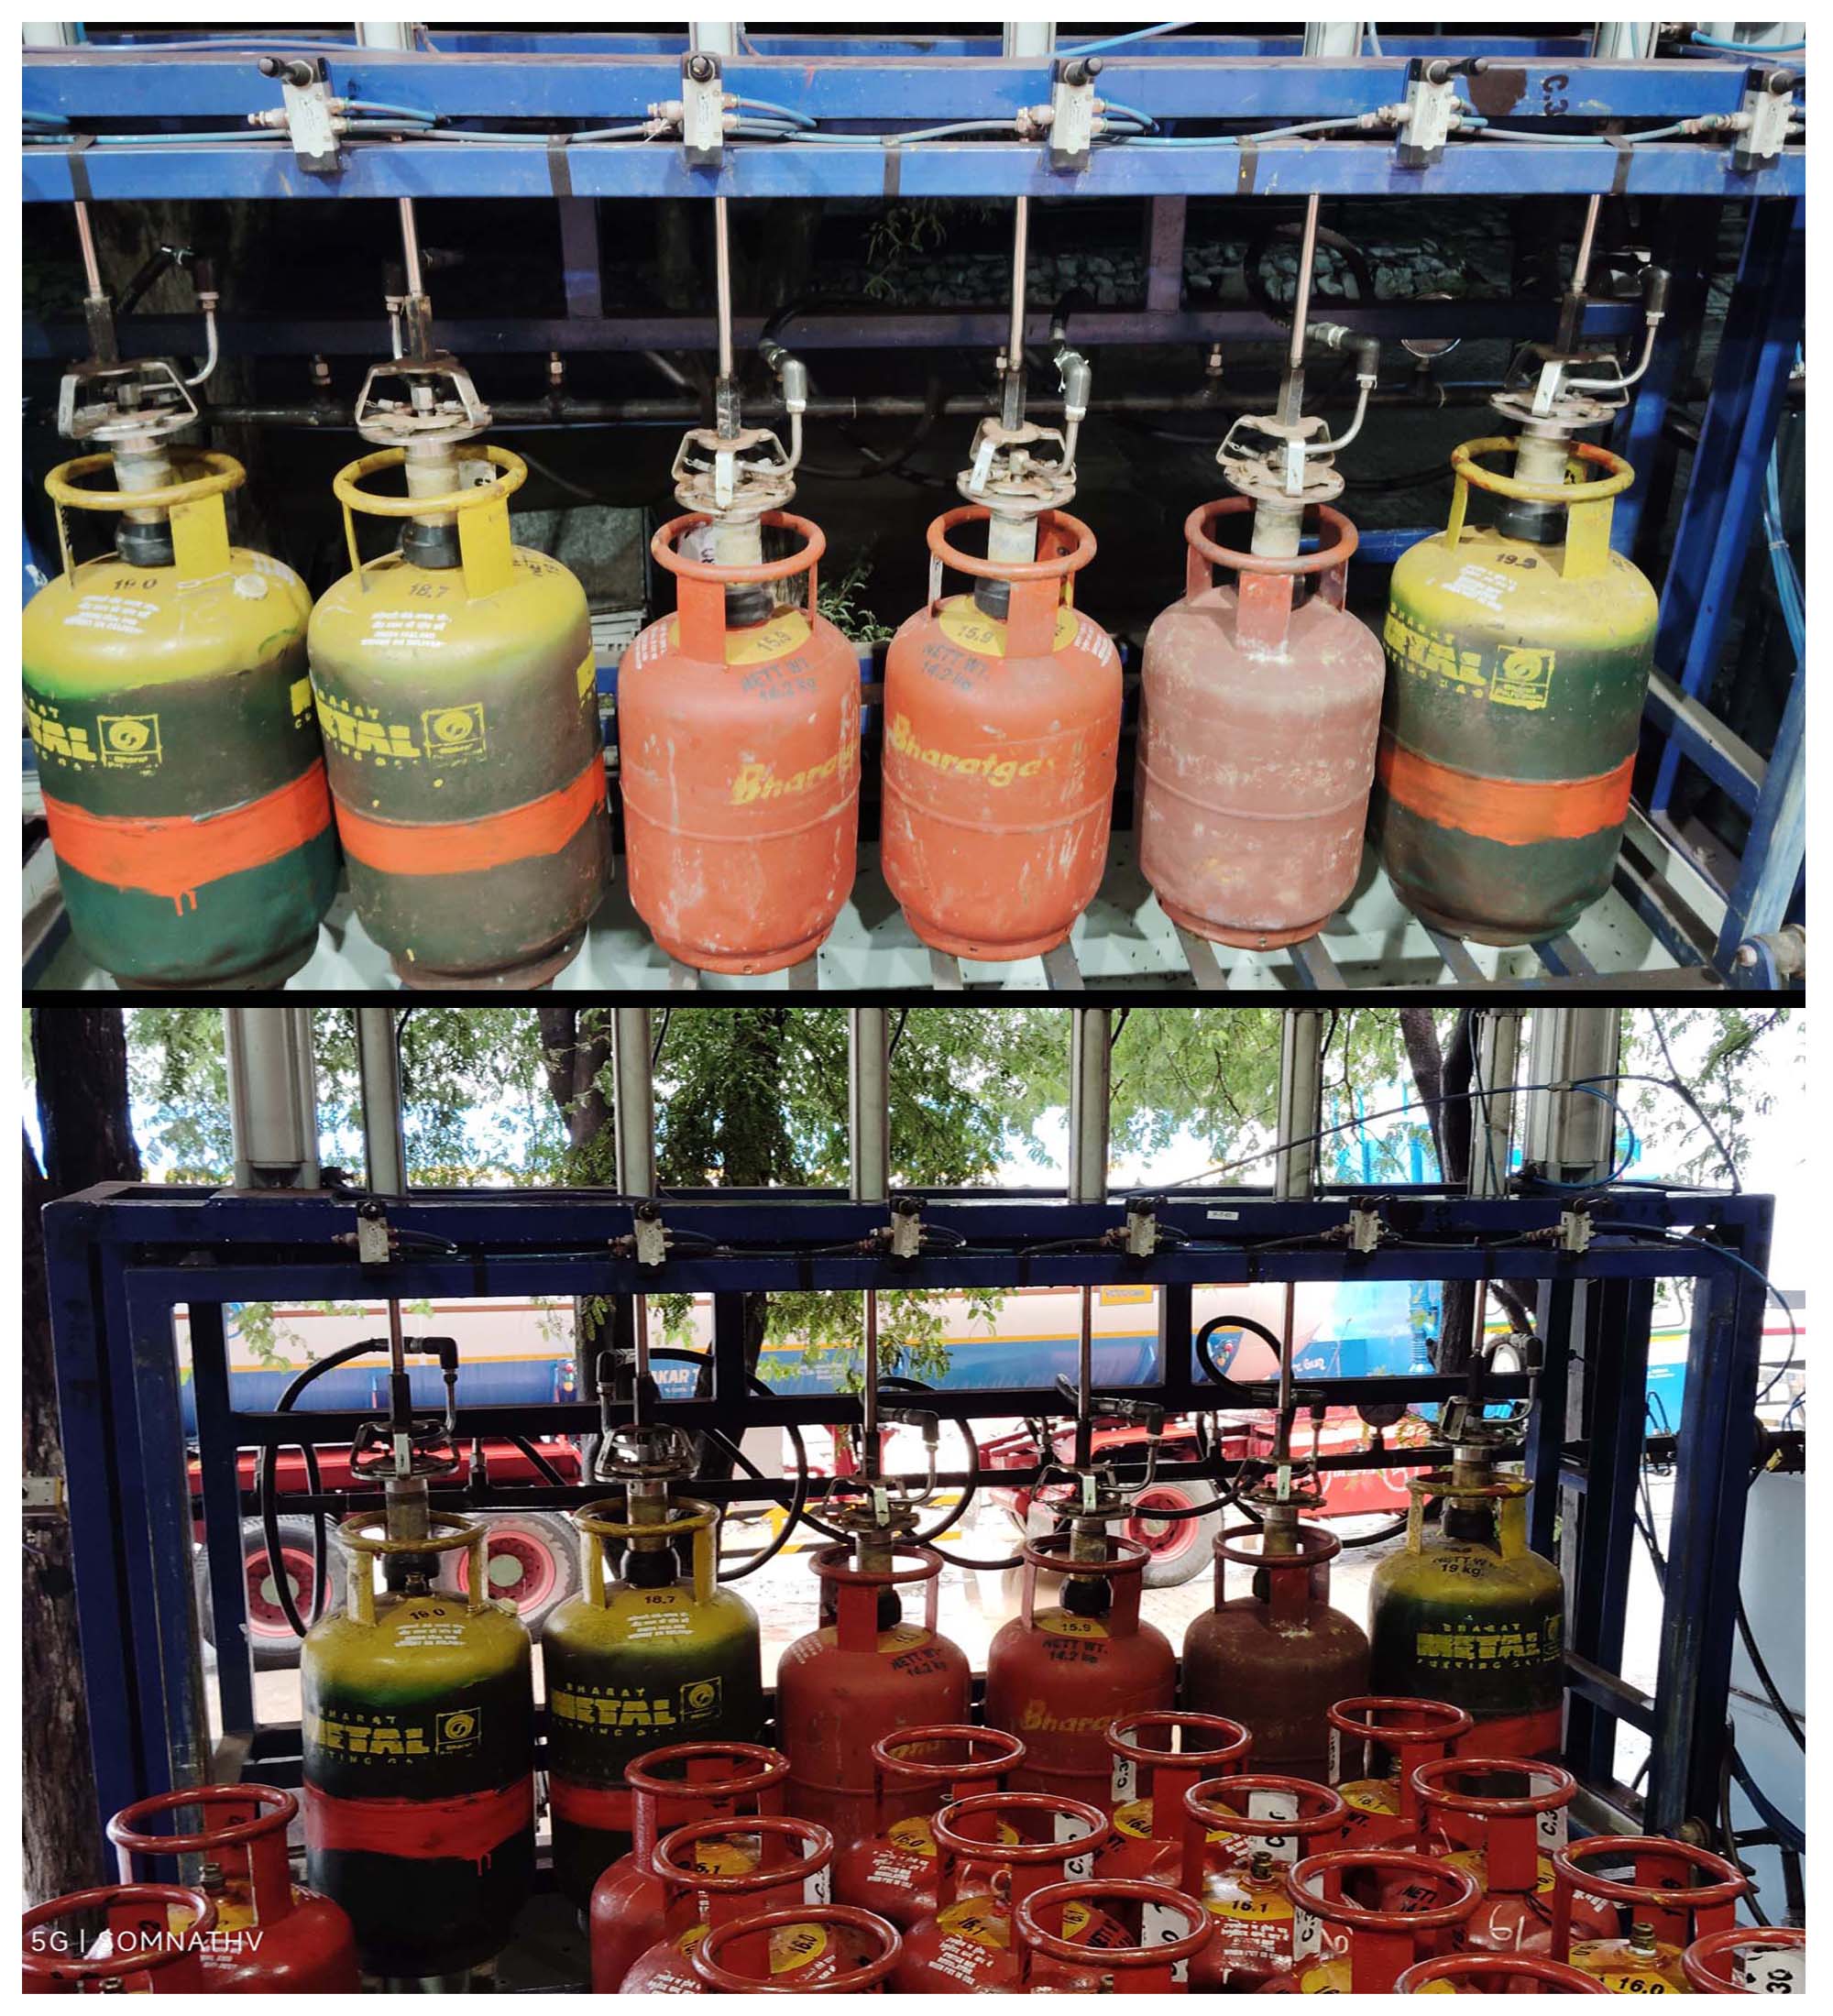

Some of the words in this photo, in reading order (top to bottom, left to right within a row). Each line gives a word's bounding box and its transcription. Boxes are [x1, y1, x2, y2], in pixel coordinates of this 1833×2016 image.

[410, 582, 450, 599] 18.7
[895, 712, 1054, 788] Bharatga
[1441, 1563, 1459, 1573] 19
[644, 1594, 675, 1605] 18.7
[565, 1682, 646, 1697] BHARAT
[1125, 1817, 1152, 1835] 16.0
[958, 1916, 990, 1936] 16.1
[791, 1934, 817, 1956] 16.0
[1619, 1977, 1665, 1995] 16.0
